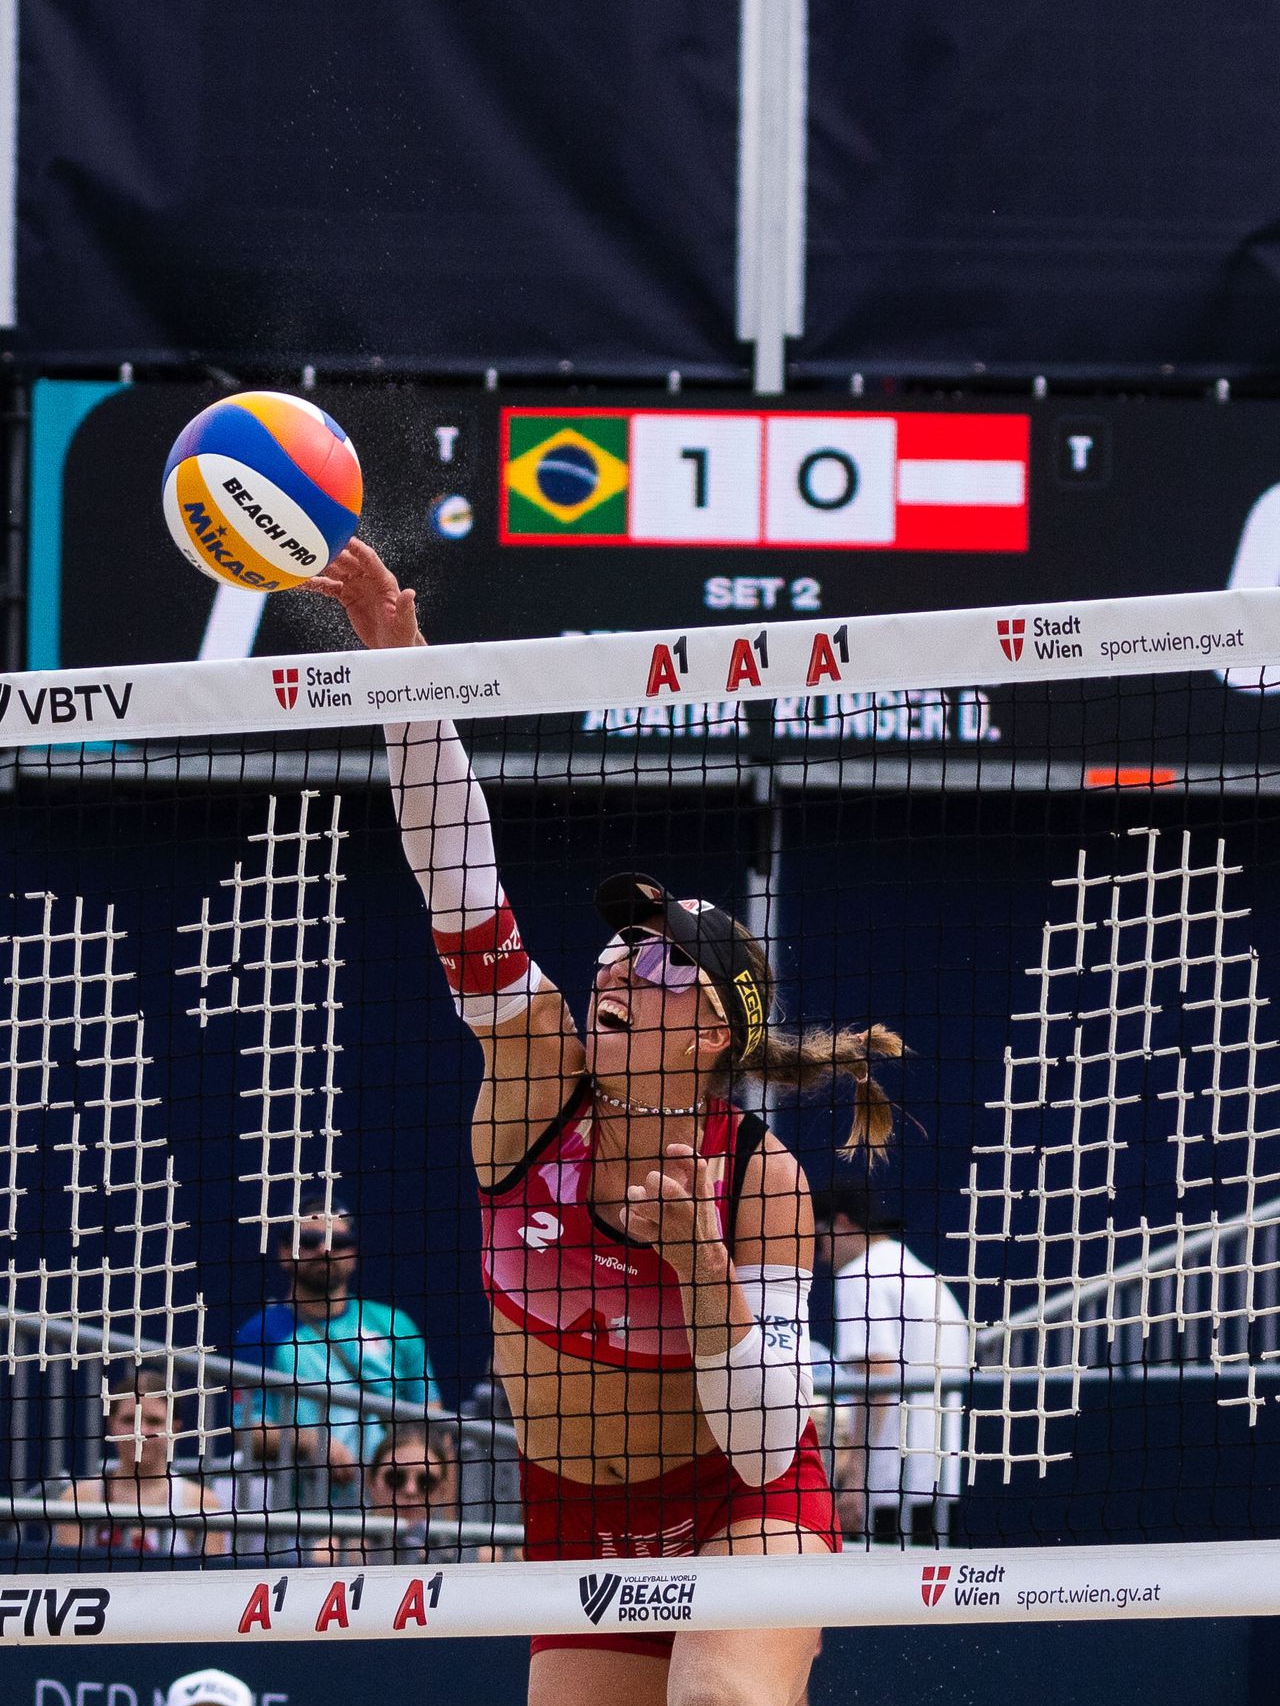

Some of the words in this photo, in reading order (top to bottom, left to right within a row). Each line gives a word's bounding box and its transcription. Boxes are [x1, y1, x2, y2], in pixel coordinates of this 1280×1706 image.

[1069, 435, 1093, 471] T
[680, 446, 710, 508] 1
[796, 445, 861, 512] 0
[222, 478, 287, 541] BEACH
[279, 540, 317, 568] PRO
[703, 576, 783, 609] SET
[788, 577, 821, 609] 2
[1033, 615, 1081, 638] Stadt
[806, 624, 850, 687] A1
[1034, 639, 1083, 660] Wien
[1100, 628, 1245, 658] sport.wien.gv.at
[306, 665, 351, 688] Stadt
[646, 635, 689, 697] A1
[726, 630, 769, 693] A1
[17, 682, 134, 725] VBTV
[306, 688, 352, 709] Wien
[366, 679, 502, 706] sport.wien.gv.at
[517, 1210, 564, 1254] 2
[624, 1575, 670, 1583] VOLLEYBALL
[957, 1564, 1005, 1584] Stadt
[238, 1576, 289, 1634] A1
[315, 1574, 365, 1633] A1
[393, 1571, 443, 1631] A1
[619, 1583, 695, 1605] BEACH
[954, 1586, 1001, 1606] Wien
[1016, 1584, 1161, 1608] sport.wien.gv.at
[619, 1606, 652, 1622] PRO
[653, 1605, 692, 1621] TOUR
